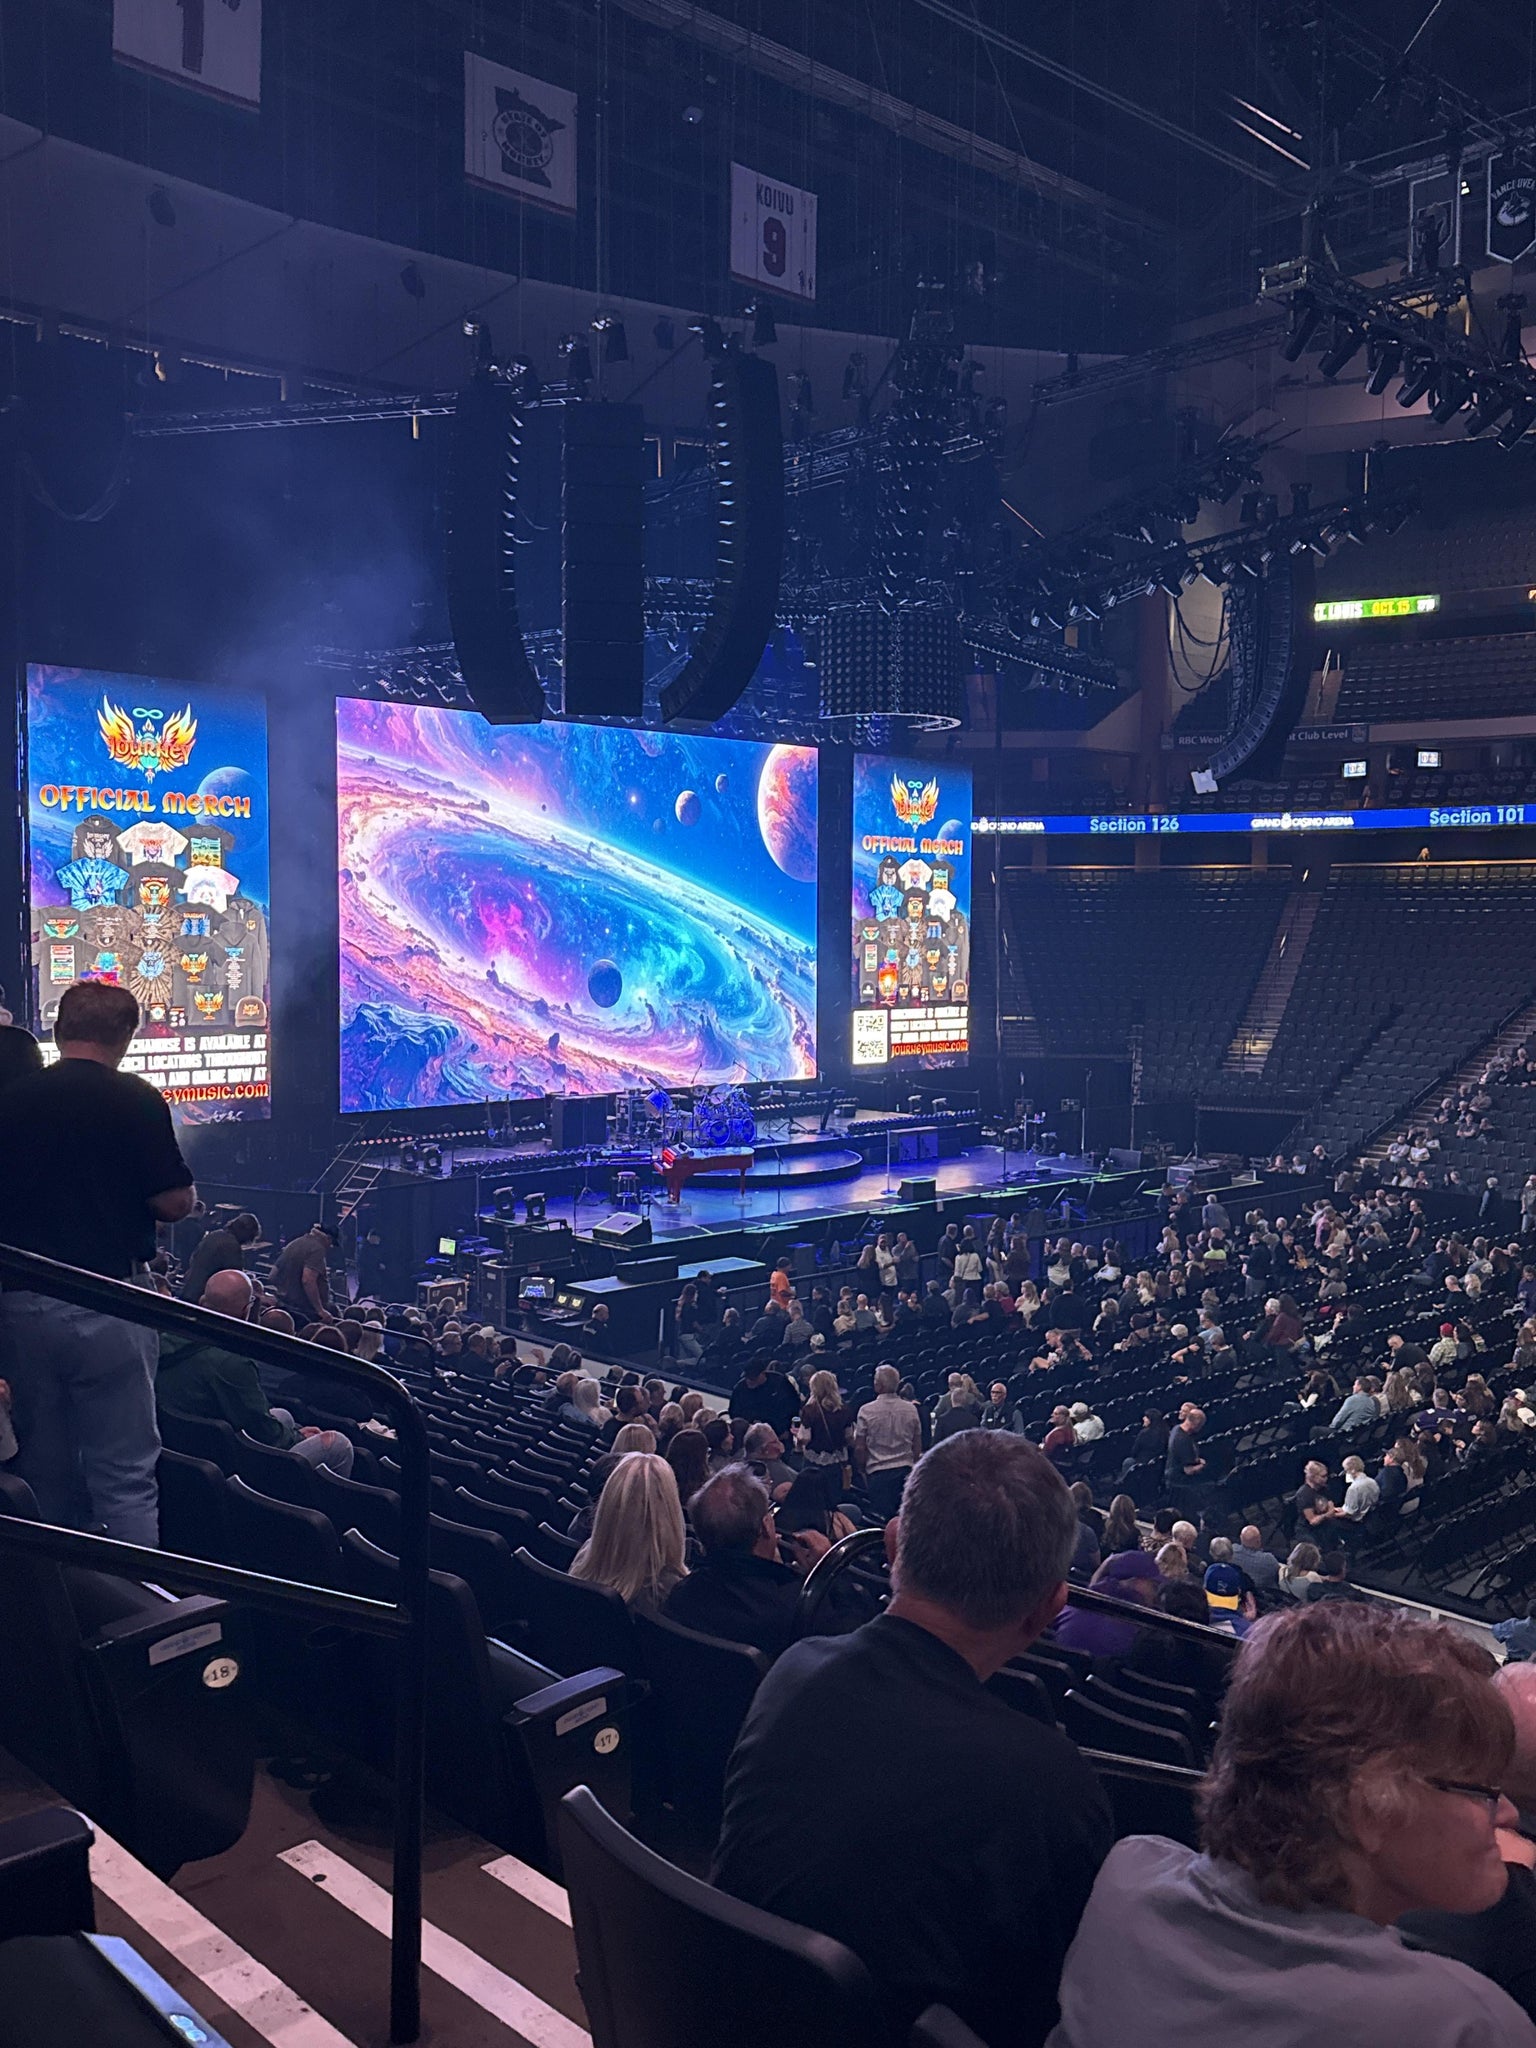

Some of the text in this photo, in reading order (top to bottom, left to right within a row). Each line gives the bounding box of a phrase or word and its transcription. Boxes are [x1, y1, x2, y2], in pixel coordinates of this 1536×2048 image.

[756, 182, 794, 216] KOIVU
[763, 217, 786, 278] 9
[1178, 734, 1227, 745] RBC Weal
[1298, 731, 1320, 741] Club
[1321, 729, 1348, 740] Level
[108, 735, 196, 766] JOURNEY
[39, 784, 251, 818] OFFICIAL MERCH
[1090, 817, 1179, 831] Section 126
[1429, 807, 1524, 825] Section 101
[862, 835, 964, 856] OFFICIAL MERCH
[184, 1037, 196, 1051] IS
[199, 1035, 251, 1051] AVAILABLE
[253, 1034, 267, 1049] AT
[147, 1053, 202, 1070] LOCATIONS
[168, 1071, 190, 1086] AND
[253, 1067, 267, 1081] AT
[211, 1665, 229, 1681] 18
[600, 1733, 612, 1747] 17
